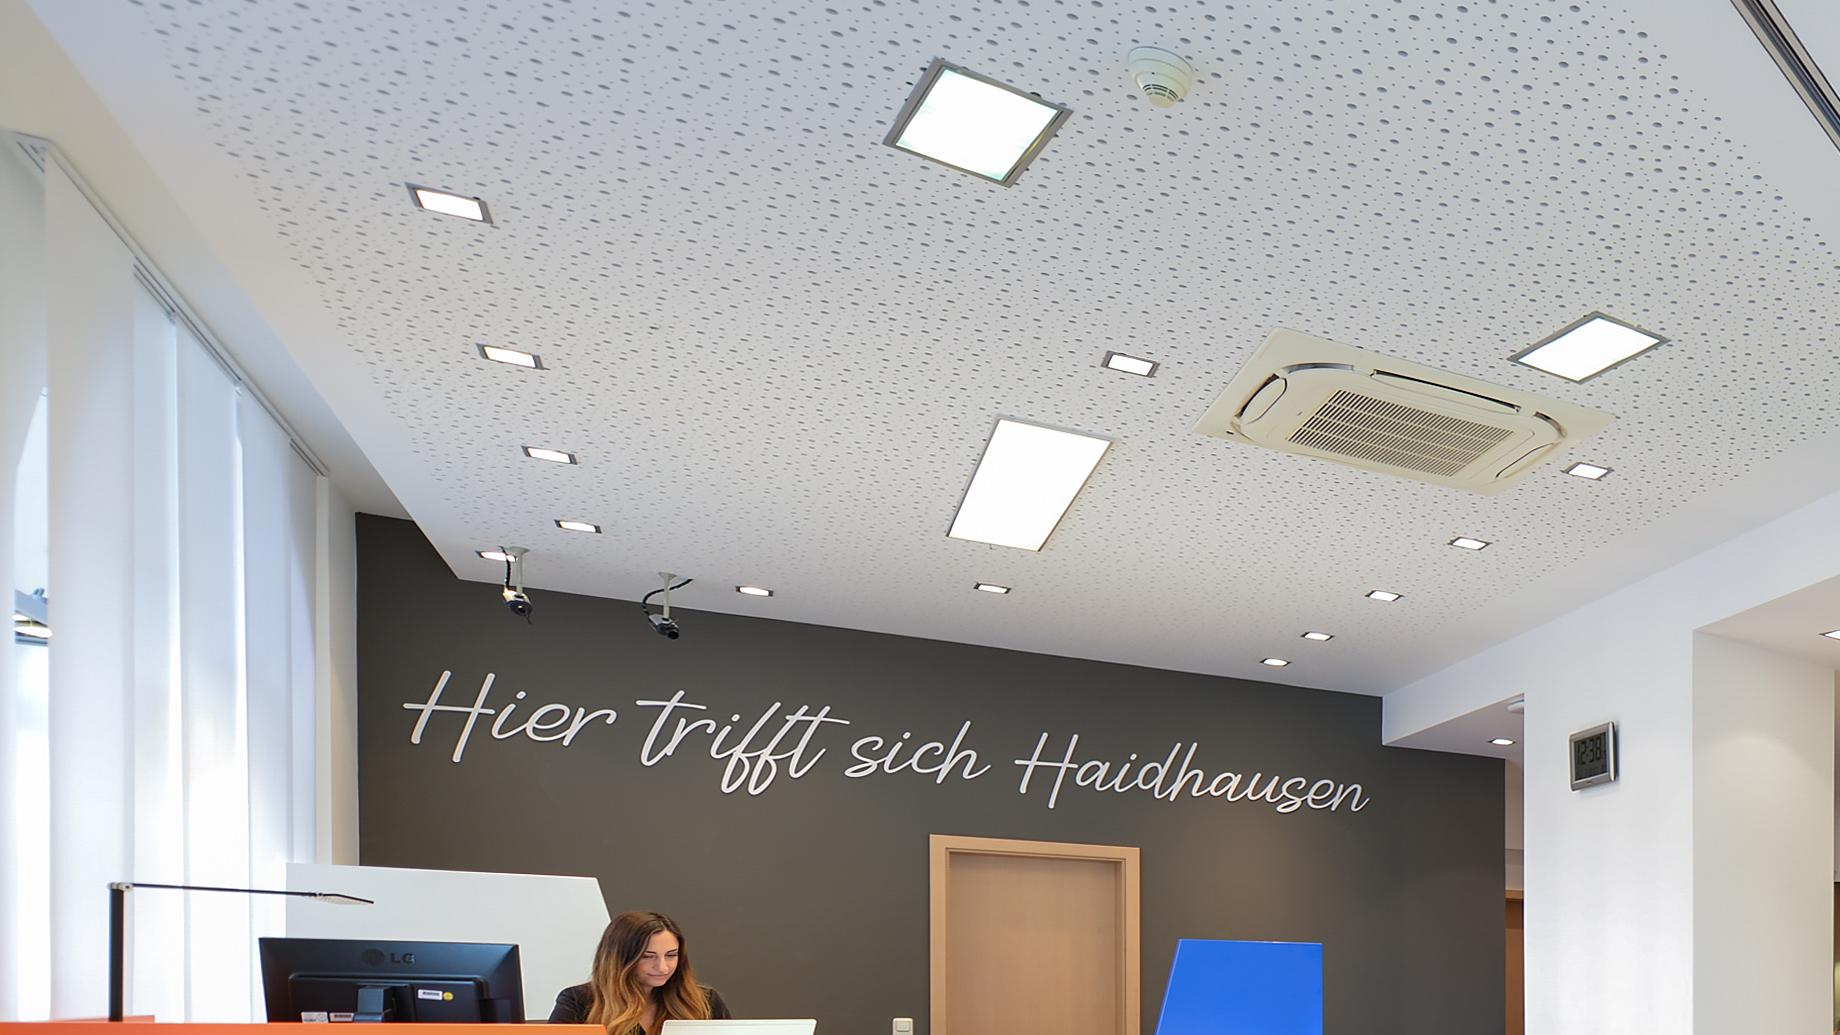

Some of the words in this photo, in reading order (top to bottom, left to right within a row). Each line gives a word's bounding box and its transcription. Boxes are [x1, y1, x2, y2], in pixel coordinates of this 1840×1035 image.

[403, 671, 616, 762] Hier
[636, 690, 850, 795] trifft
[845, 721, 991, 784] sich
[1015, 732, 1369, 812] Haidhausen
[390, 952, 416, 965] LG
